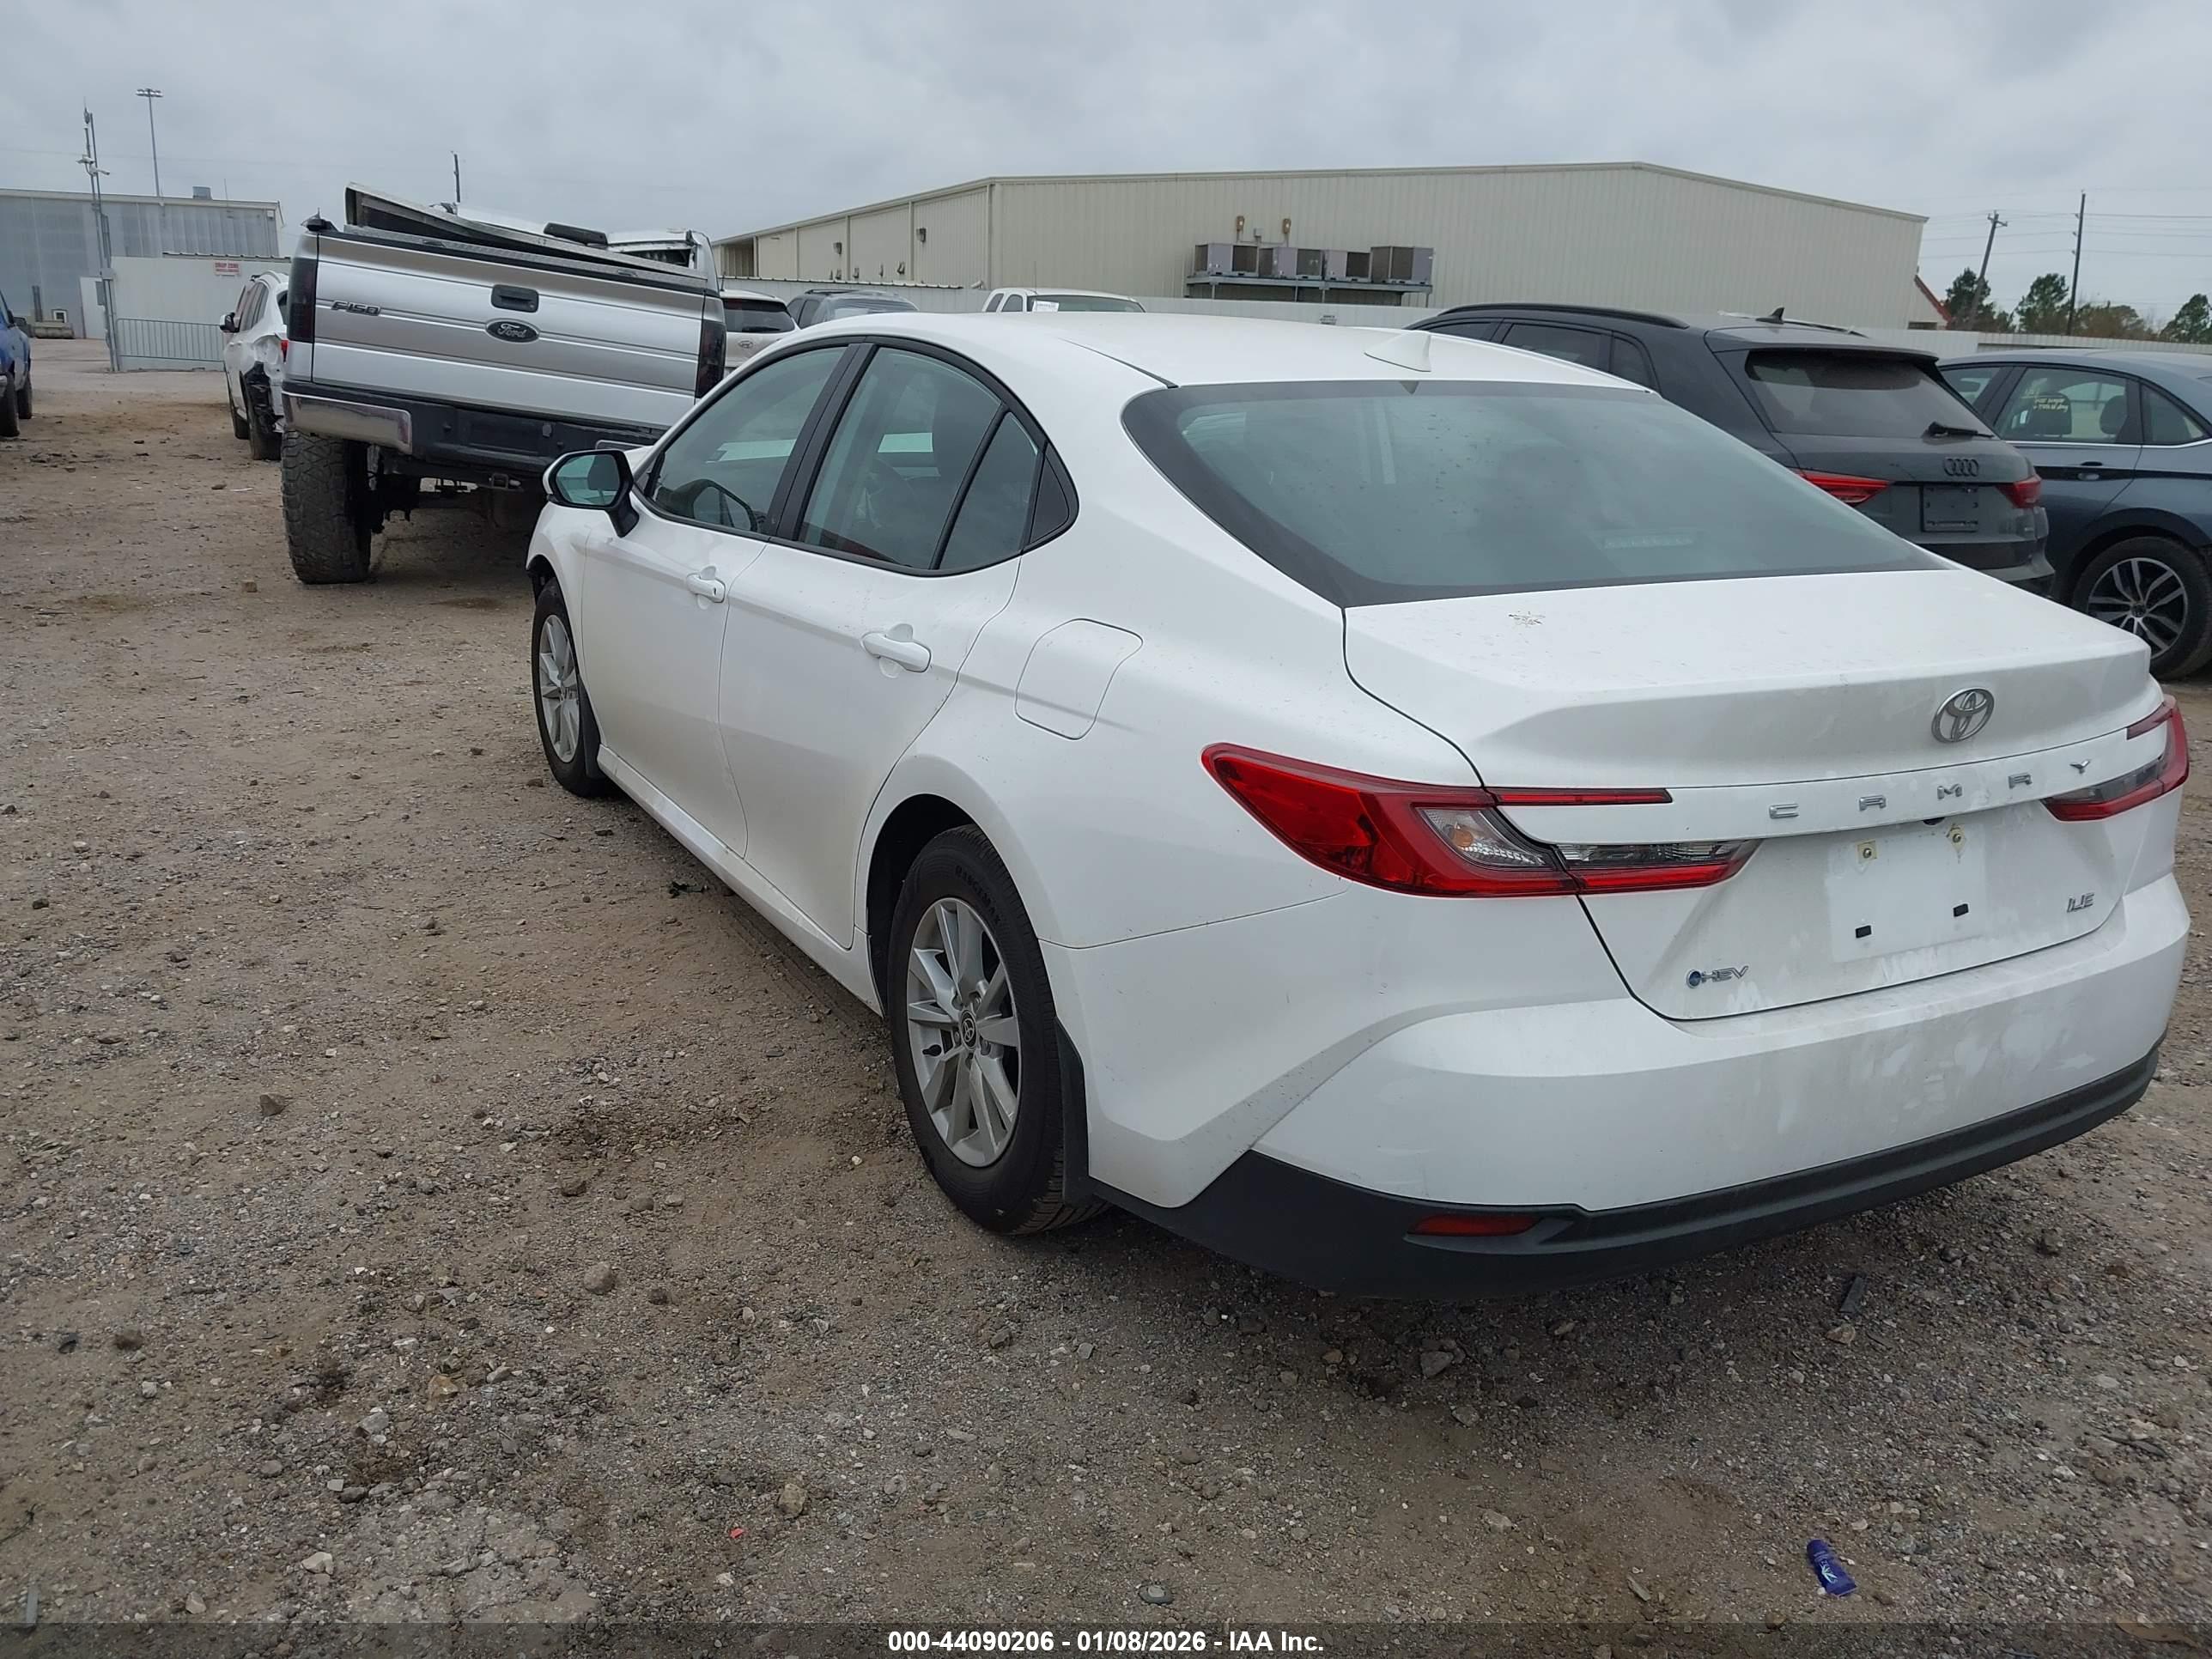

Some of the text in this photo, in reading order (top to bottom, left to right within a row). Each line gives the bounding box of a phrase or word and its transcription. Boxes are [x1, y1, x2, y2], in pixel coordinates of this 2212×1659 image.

[497, 323, 526, 337] Ford
[1769, 759, 2090, 819] CAMRY
[2066, 893, 2095, 914] LE
[1700, 965, 1749, 984] HEV
